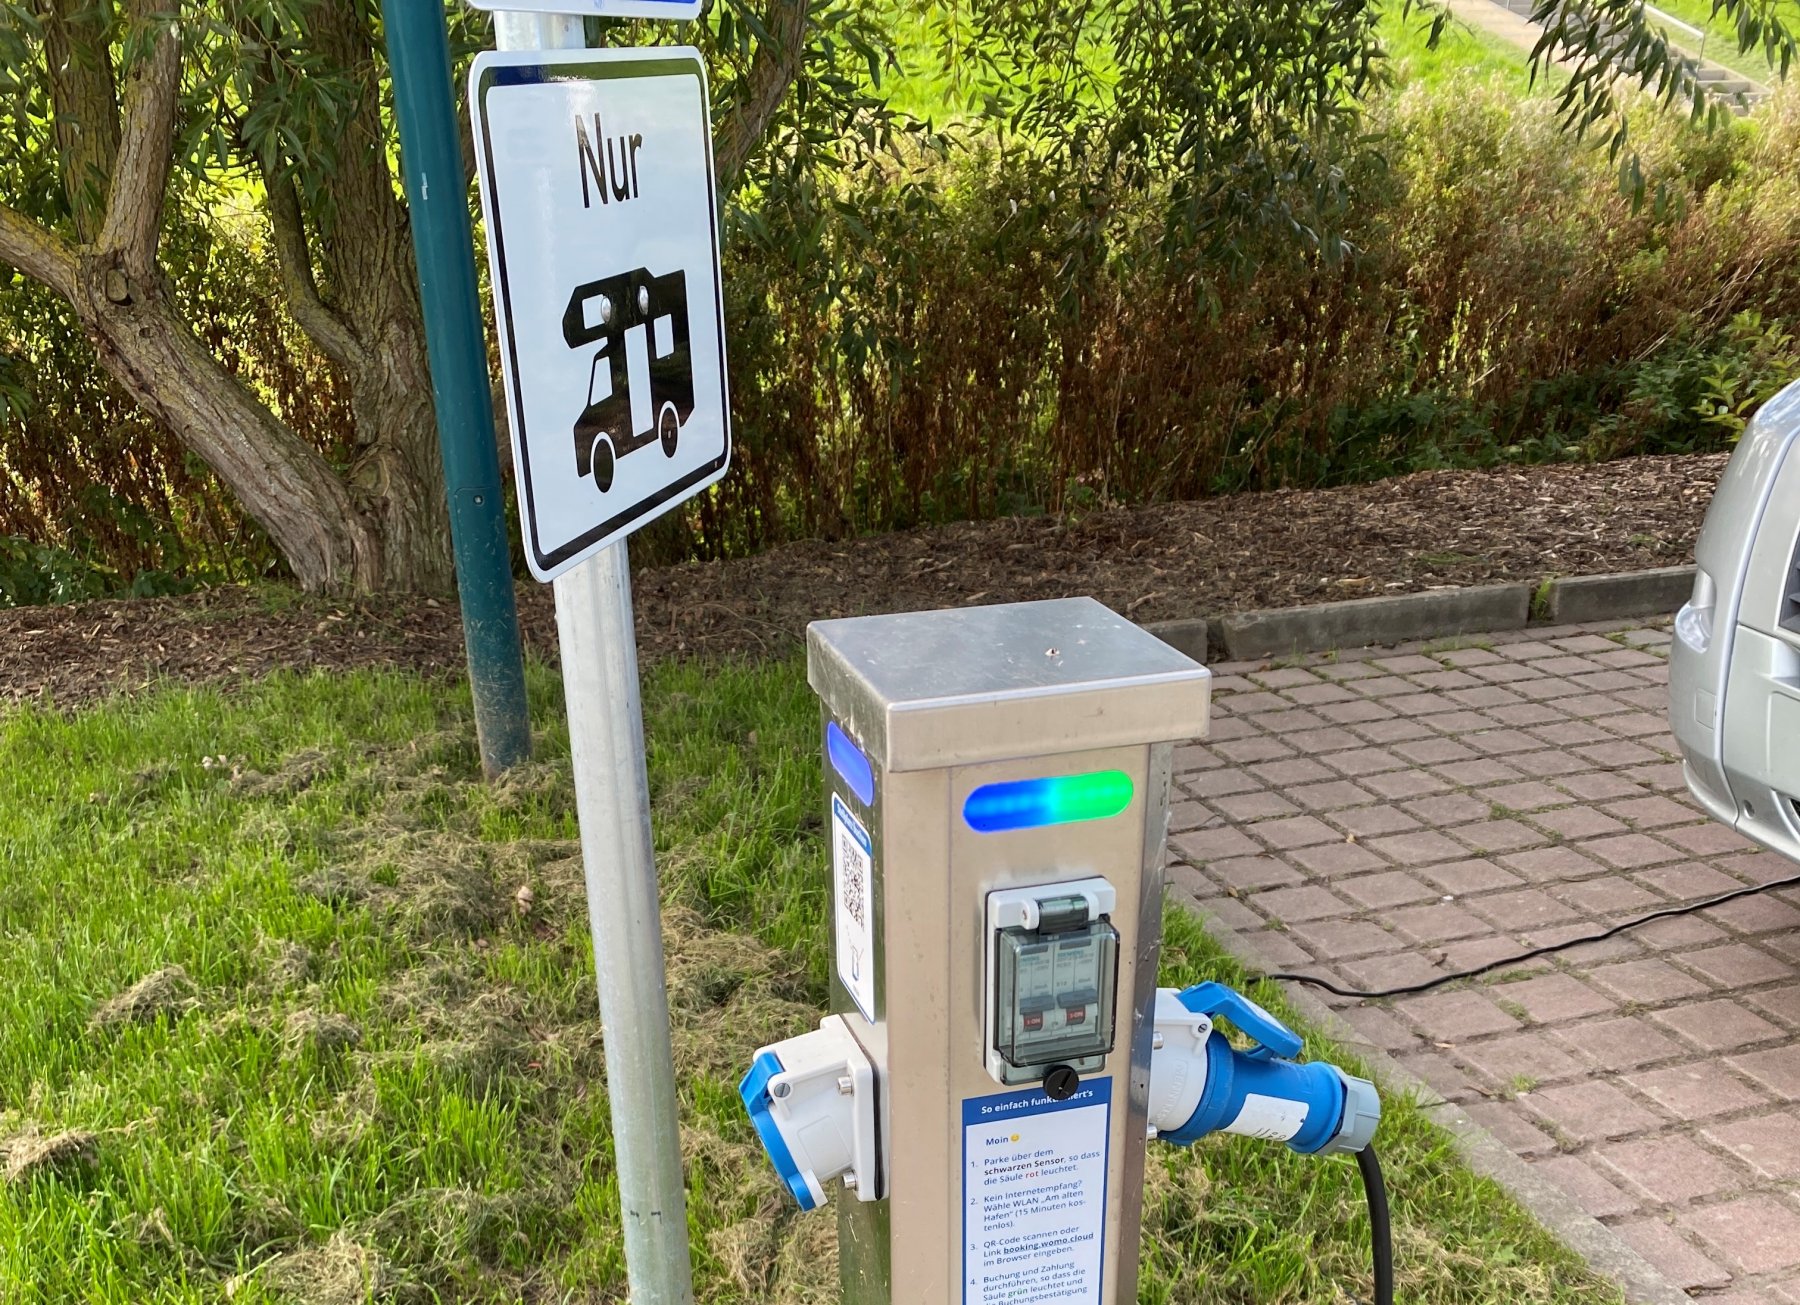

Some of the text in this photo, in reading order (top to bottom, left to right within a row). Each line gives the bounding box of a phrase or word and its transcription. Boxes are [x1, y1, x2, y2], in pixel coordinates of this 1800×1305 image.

[576, 112, 642, 208] Nur
[981, 1105, 992, 1114] So
[994, 1100, 1028, 1112] einfach
[986, 1136, 1008, 1146] Moin
[984, 1156, 1009, 1166] Parke
[1012, 1152, 1032, 1162] über
[1034, 1148, 1054, 1158] dem
[984, 1163, 1032, 1176] schwarzen
[1034, 1156, 1066, 1168] Sensor,
[1080, 1151, 1100, 1160] dass
[984, 1177, 998, 1186] die
[1000, 1173, 1023, 1183] Säule
[1026, 1171, 1039, 1179] rot
[984, 1194, 1003, 1203] Kein
[1005, 1180, 1082, 1198] Internetempfang?
[984, 1202, 1010, 1212] Wähle
[1013, 1198, 1039, 1208] WLAN
[1062, 1190, 1084, 1200] alten
[1015, 1208, 1028, 1218] (15
[1030, 1202, 1066, 1214] Minuten
[984, 1236, 1020, 1248] QR-Code
[1022, 1230, 1058, 1242] scannen
[1060, 1226, 1079, 1236] oder
[984, 1232, 1094, 1258] Link booking.womo.cloud
[996, 1254, 1032, 1265] Browser
[984, 1272, 1020, 1283] Buchung
[1041, 1262, 1074, 1272] Zahlung
[1052, 1270, 1070, 1280] dass
[1073, 1268, 1086, 1276] die
[984, 1278, 1083, 1302] Säule grün leuchtet und
